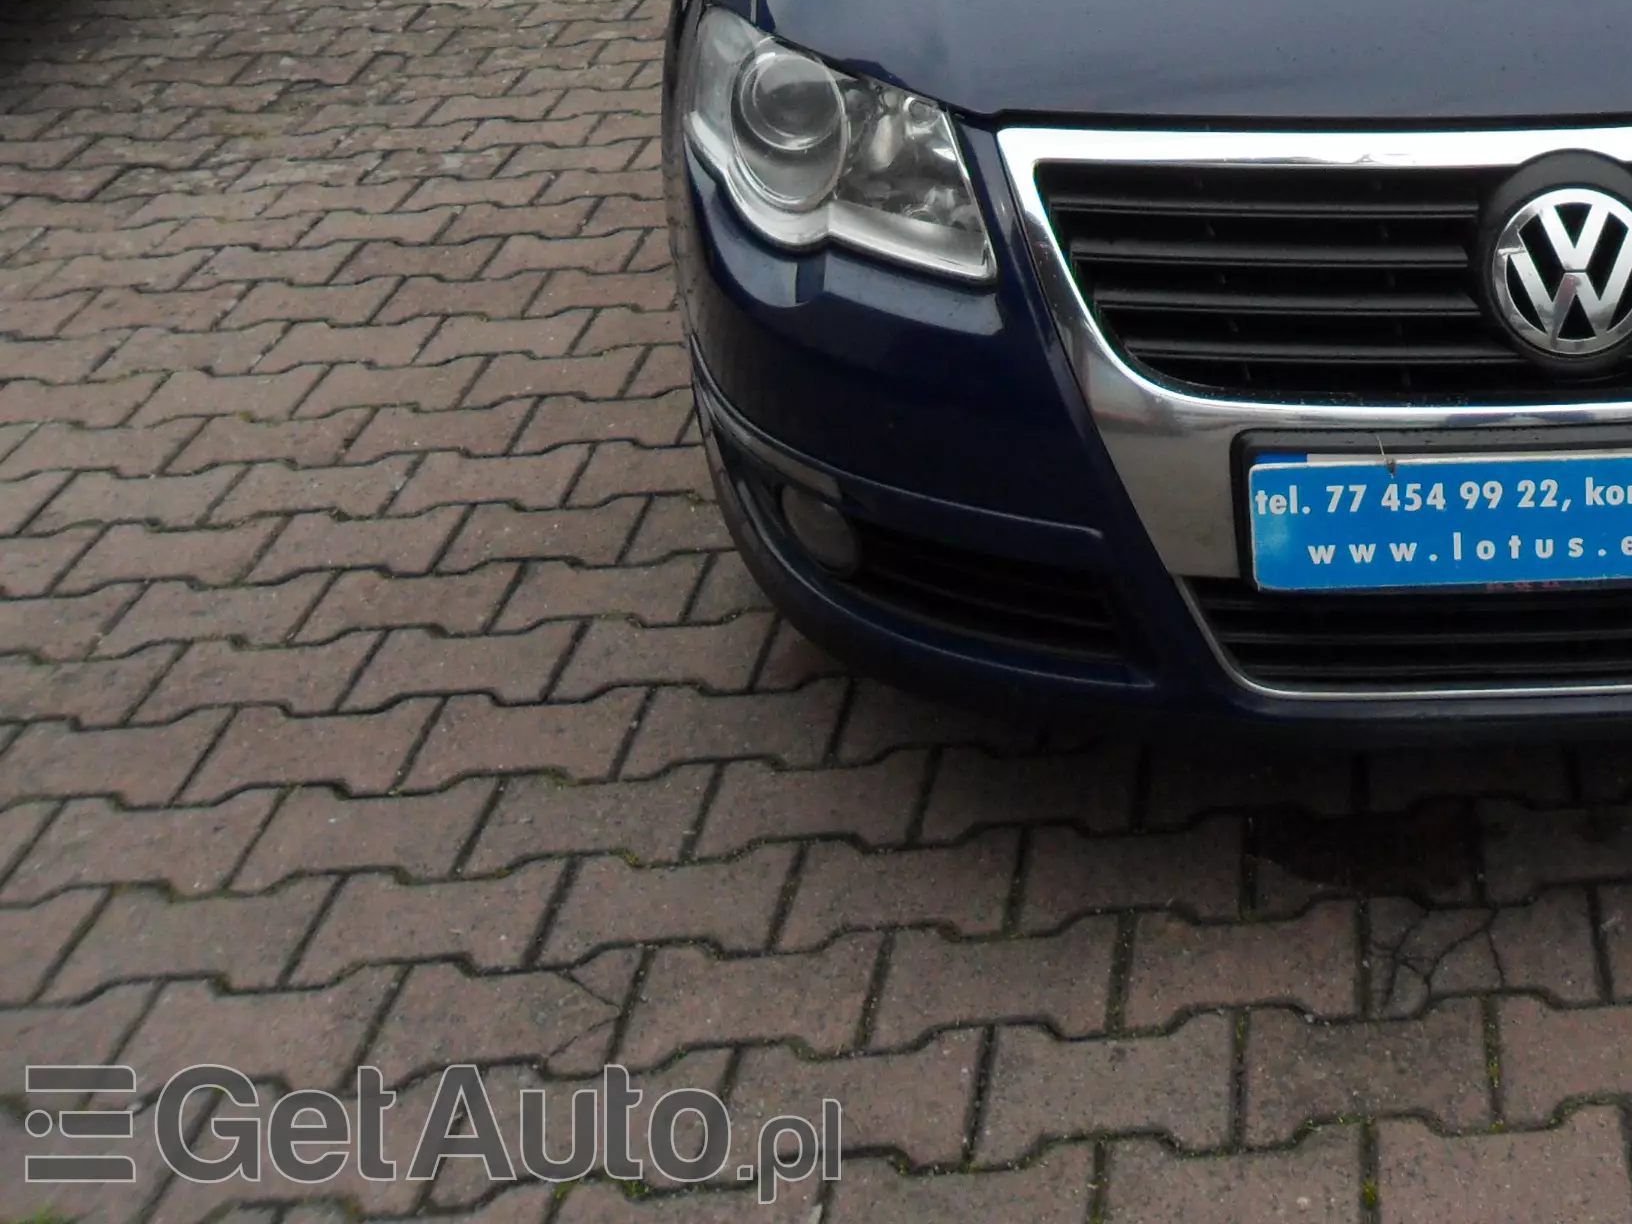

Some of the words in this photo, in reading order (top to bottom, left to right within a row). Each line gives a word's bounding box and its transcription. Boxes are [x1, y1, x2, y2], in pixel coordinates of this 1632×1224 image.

[1255, 485, 1311, 515] tel.
[1326, 484, 1367, 513] 77
[1381, 483, 1446, 512] 454
[1459, 481, 1503, 510] 99
[1517, 479, 1572, 512] 22,
